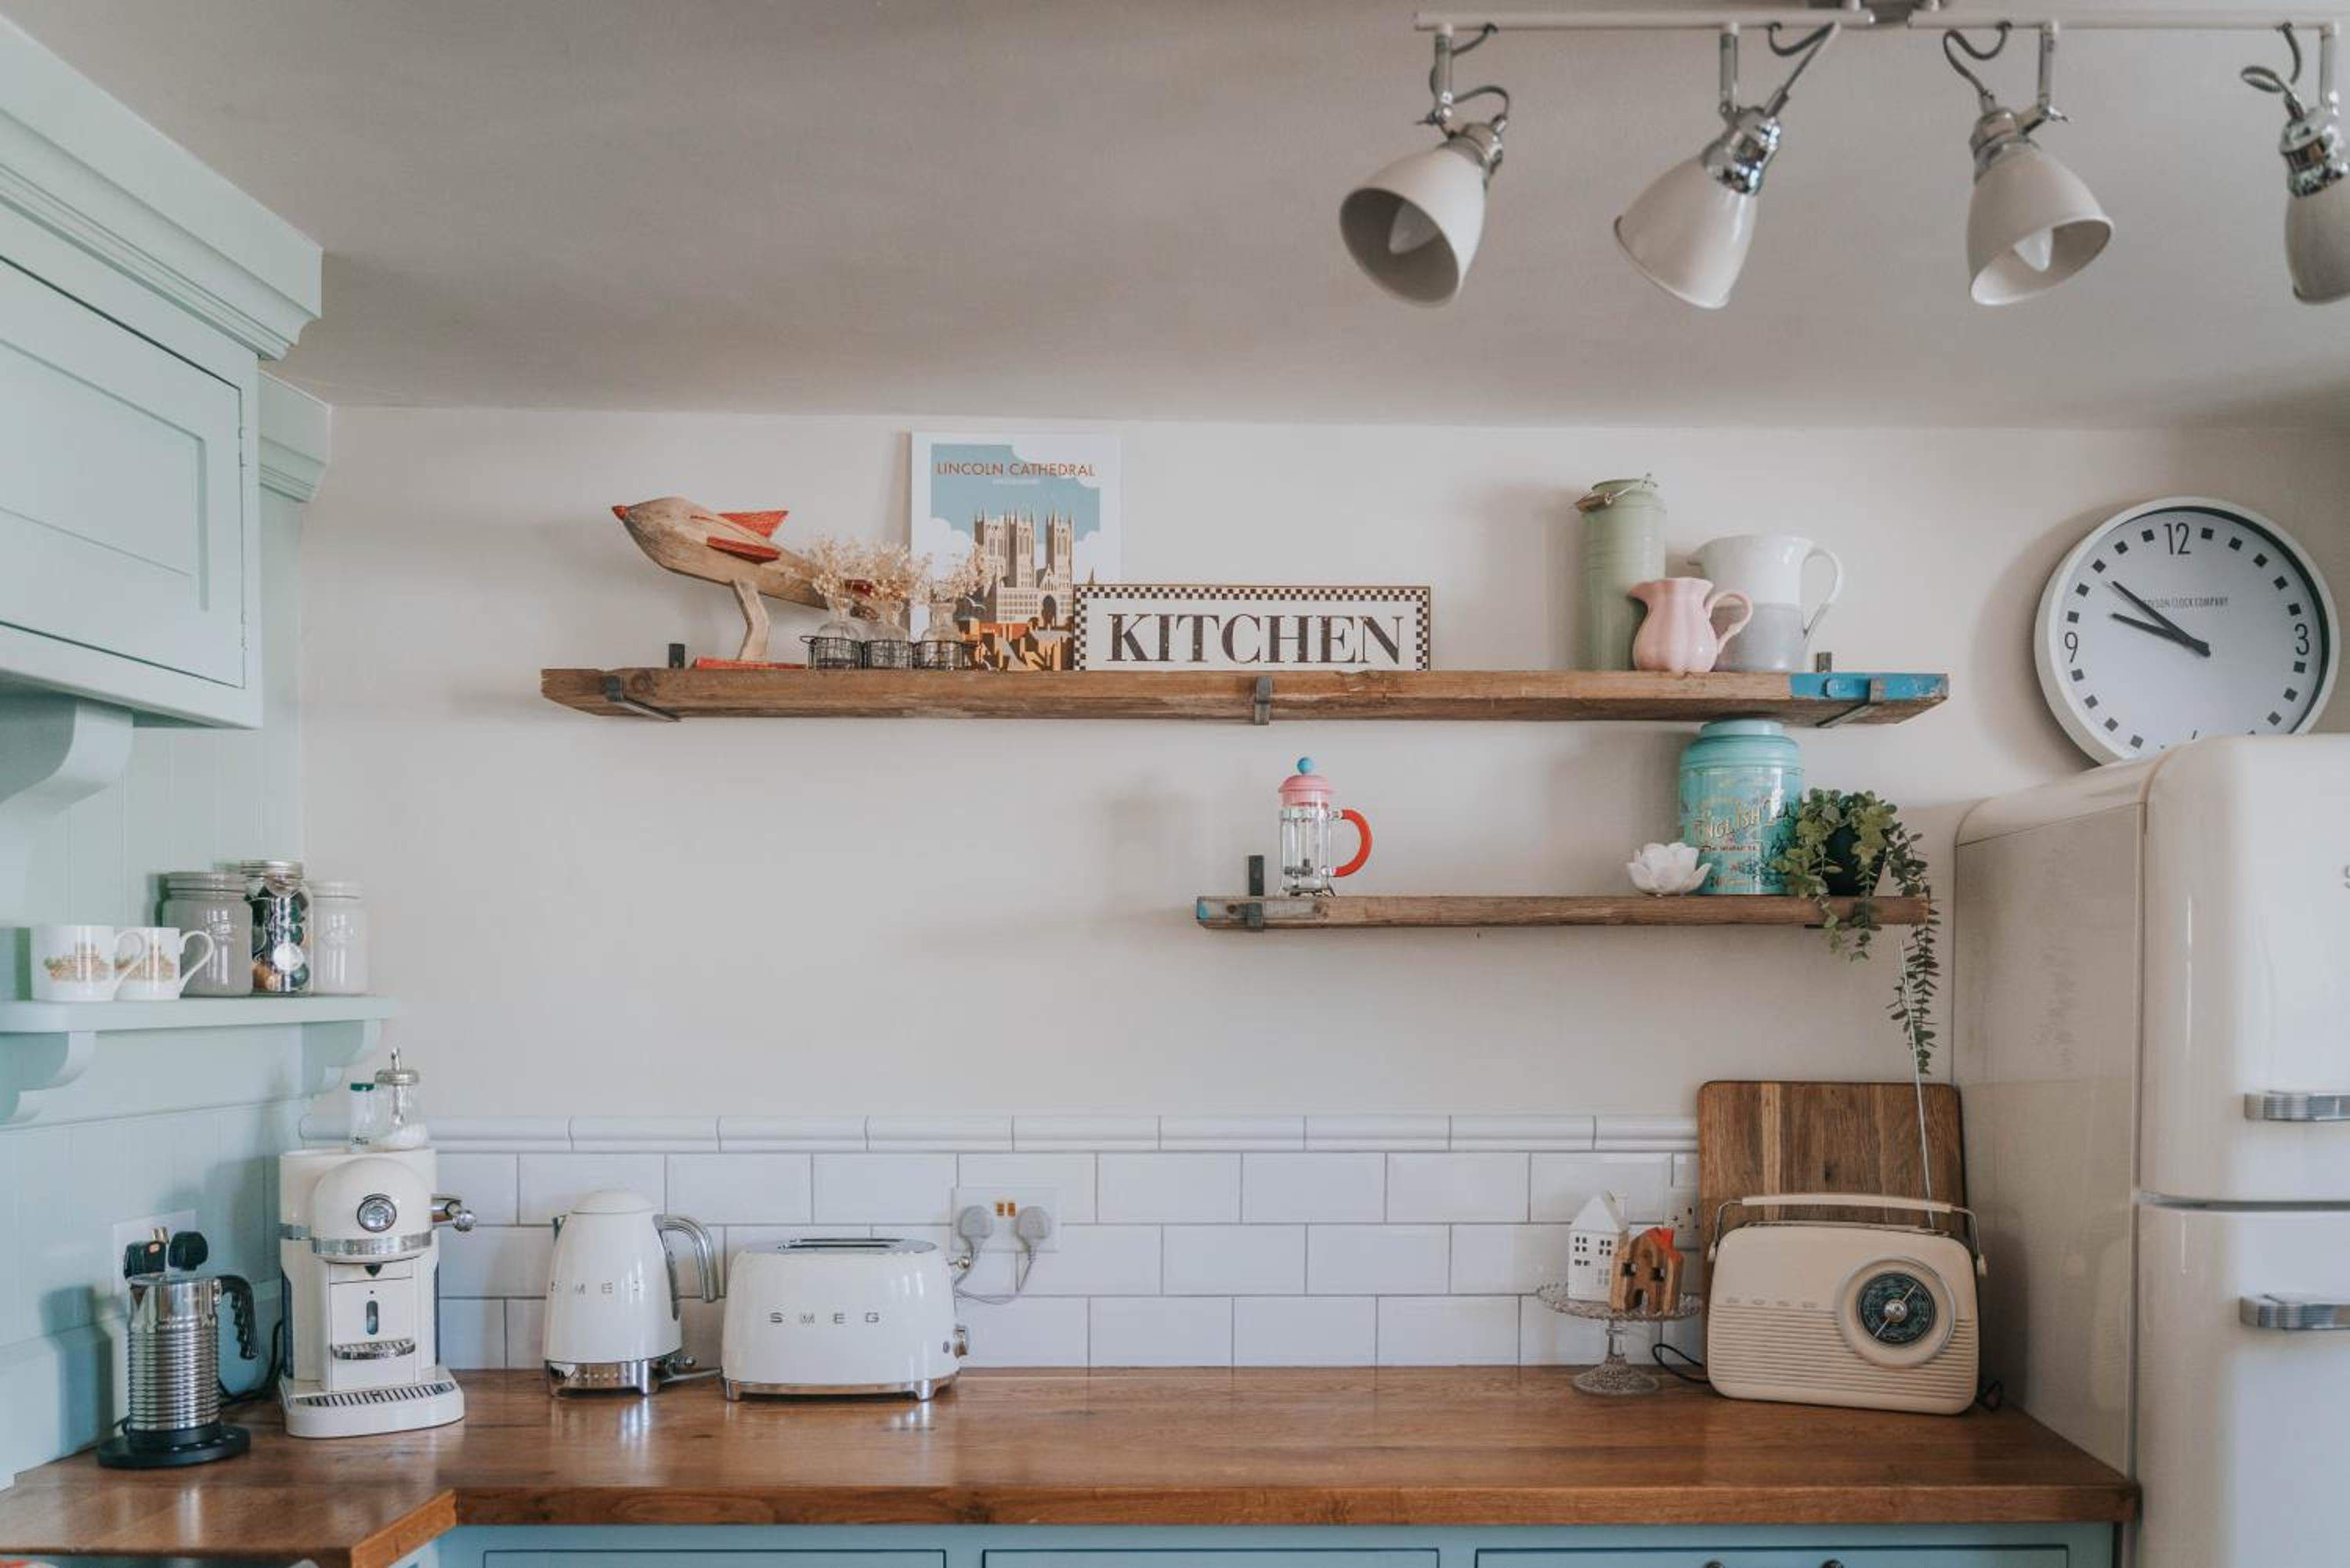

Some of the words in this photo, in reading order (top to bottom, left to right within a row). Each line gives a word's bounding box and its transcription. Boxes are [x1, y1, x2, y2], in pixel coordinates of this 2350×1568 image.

[937, 463, 1003, 476] LINCOLN
[1008, 463, 1096, 476] CATHEDRAL
[2164, 522, 2191, 555] 12
[2193, 596, 2229, 607] COMPANY
[1106, 613, 1404, 664] KITCHEN
[2064, 631, 2079, 663] 9
[2294, 623, 2310, 656] 3
[770, 1312, 879, 1324] SMEG
